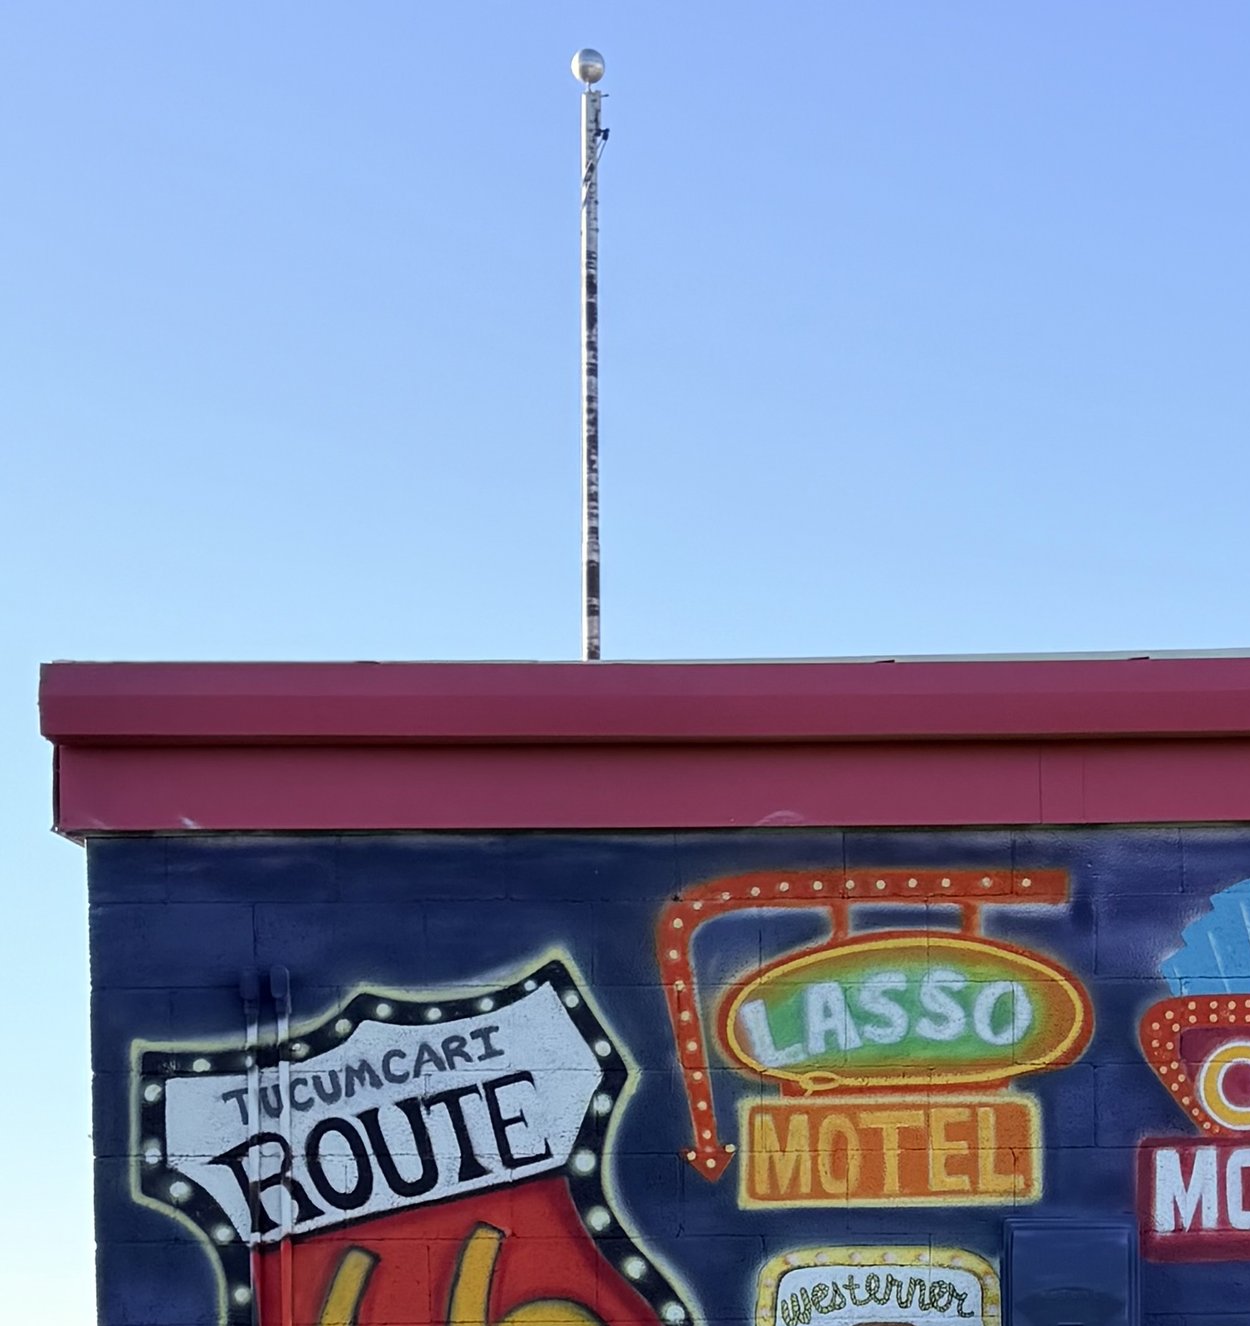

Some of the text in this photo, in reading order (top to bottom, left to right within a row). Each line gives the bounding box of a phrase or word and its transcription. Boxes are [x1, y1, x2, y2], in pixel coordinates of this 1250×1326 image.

[739, 966, 1034, 1068] LASSO
[222, 1024, 506, 1126] TUCUMCARI
[208, 1070, 553, 1233] ROUTE
[752, 1106, 1025, 1195] MOTEL
